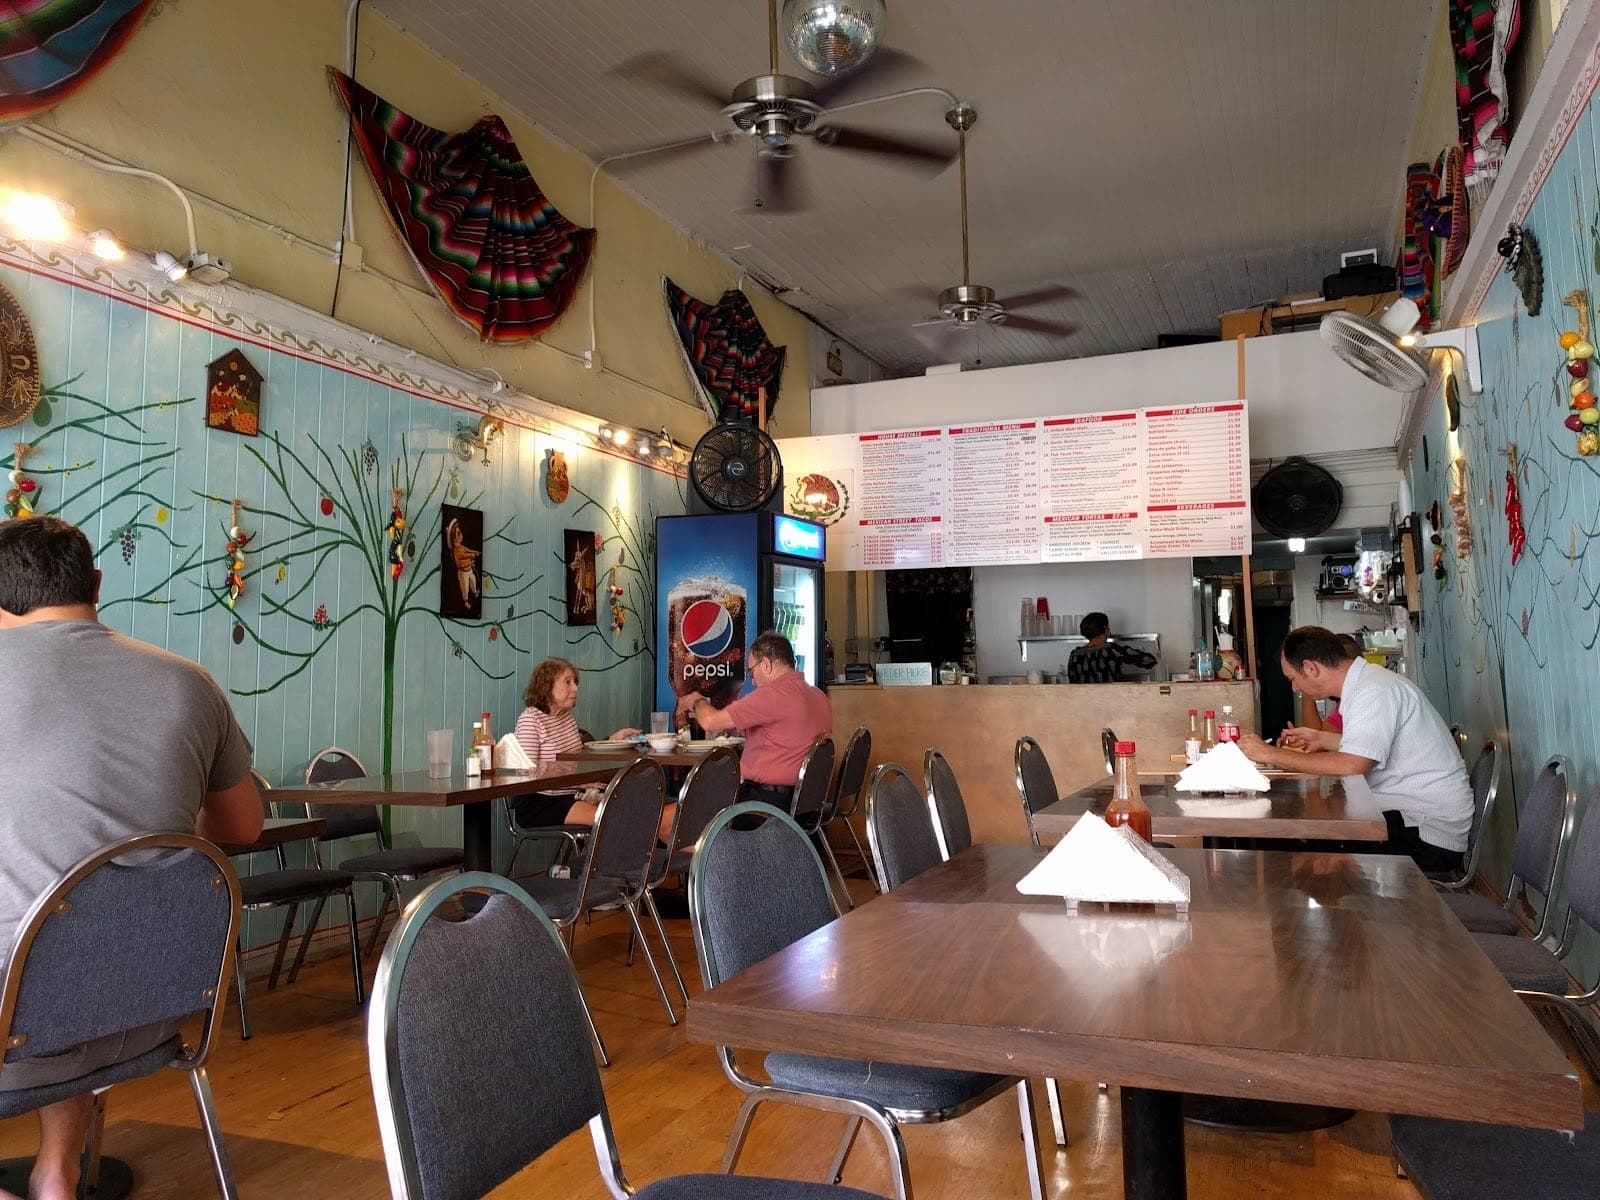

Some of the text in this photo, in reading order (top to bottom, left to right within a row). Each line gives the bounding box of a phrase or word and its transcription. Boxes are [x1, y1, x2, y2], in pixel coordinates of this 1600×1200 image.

[963, 426, 1000, 434] TRADITIONAL
[878, 432, 895, 440] HOUSE
[684, 660, 731, 681] pepsi
[906, 666, 928, 680] HERE
